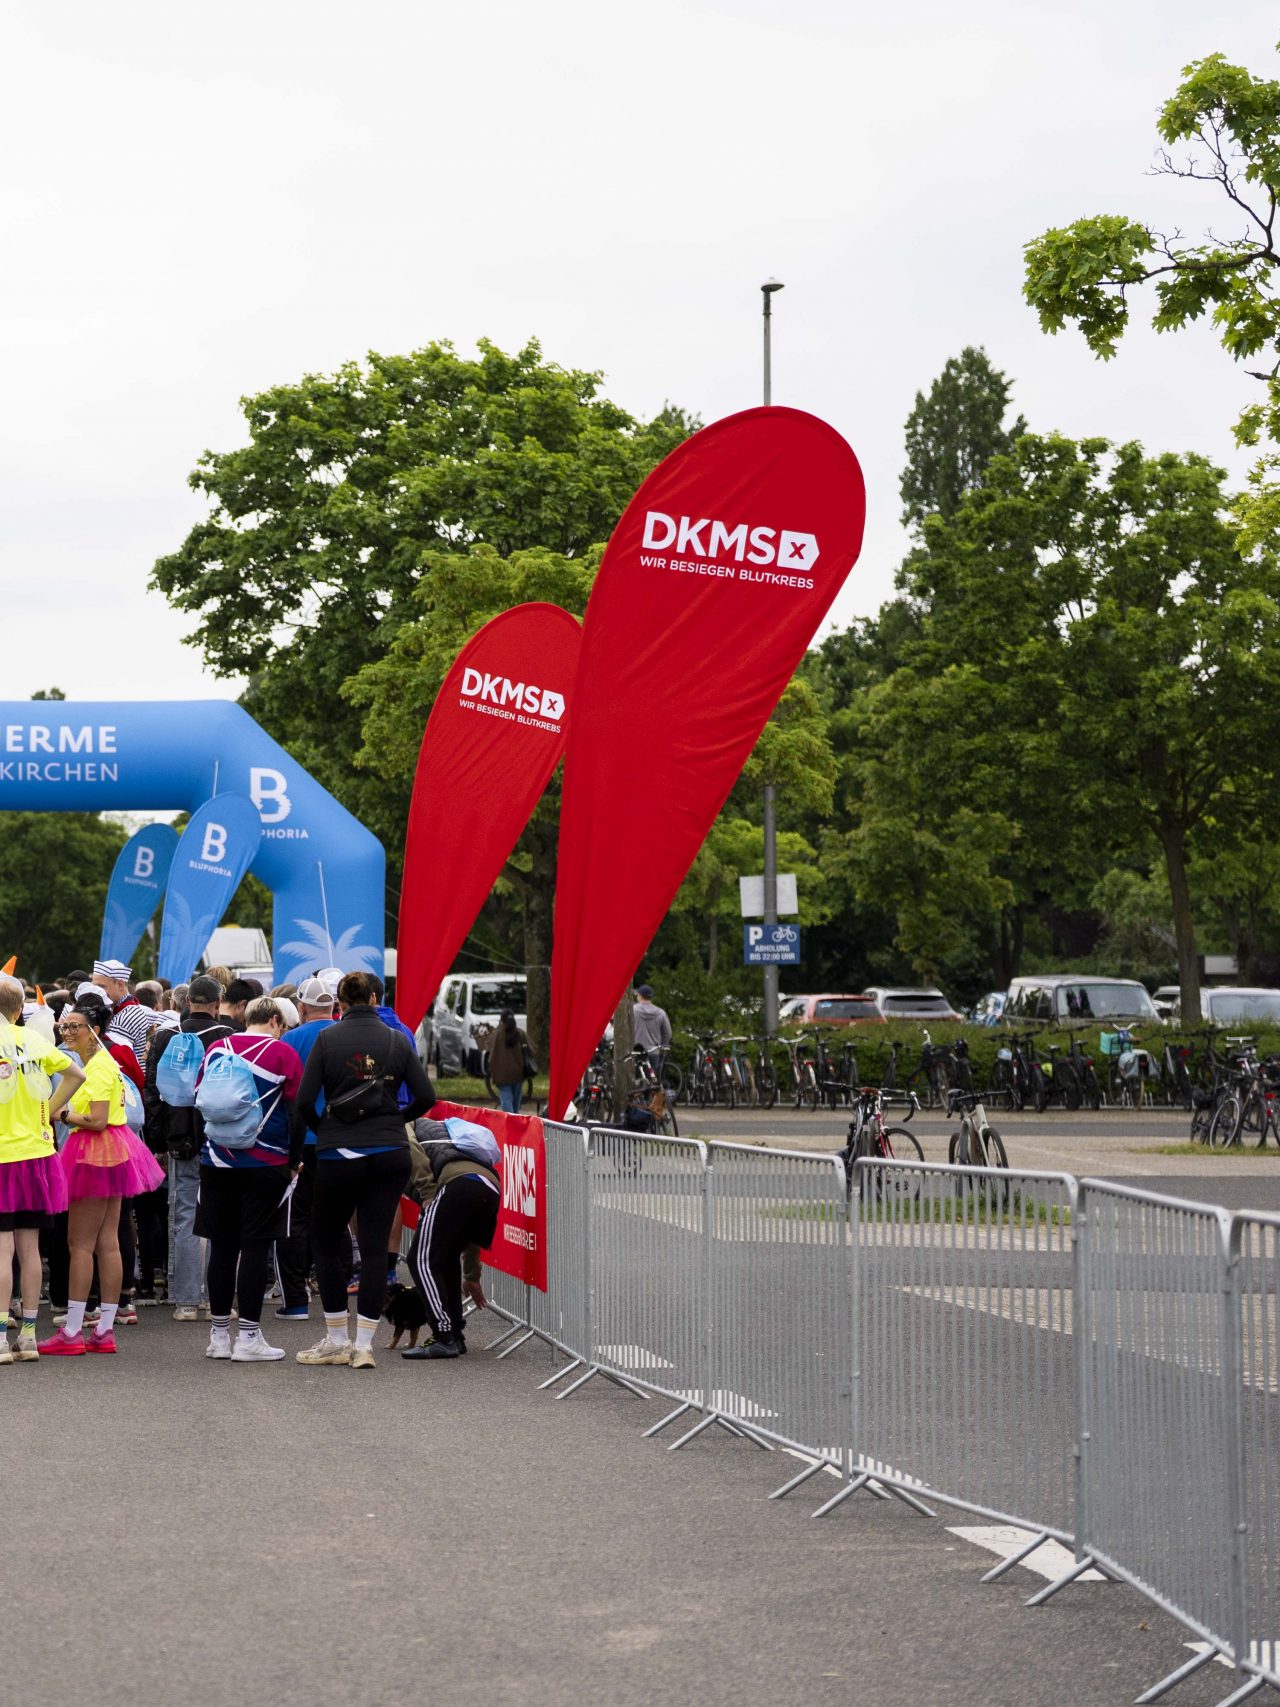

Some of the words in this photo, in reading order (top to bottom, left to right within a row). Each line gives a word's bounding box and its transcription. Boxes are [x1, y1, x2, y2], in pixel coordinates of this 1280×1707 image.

[641, 511, 777, 565] DKMS
[640, 555, 667, 569] WIR
[670, 560, 735, 578] BESIEGEN
[739, 569, 815, 590] BLUTKREBS
[461, 667, 541, 714] DKMS
[459, 698, 475, 710] WIR
[477, 704, 516, 721] BESIEGEN
[517, 715, 561, 734] BLUTKREBS
[250, 767, 292, 824] B
[200, 822, 228, 863] B
[133, 845, 155, 878] B
[188, 860, 232, 878] BLUPHORIA
[749, 926, 763, 946] P
[755, 944, 790, 952] ABHOLUNG
[749, 952, 761, 961] BIS
[762, 952, 780, 961] 22:00
[781, 952, 795, 960] UHR
[177, 1052, 185, 1062] B
[503, 1143, 528, 1216] DKMS
